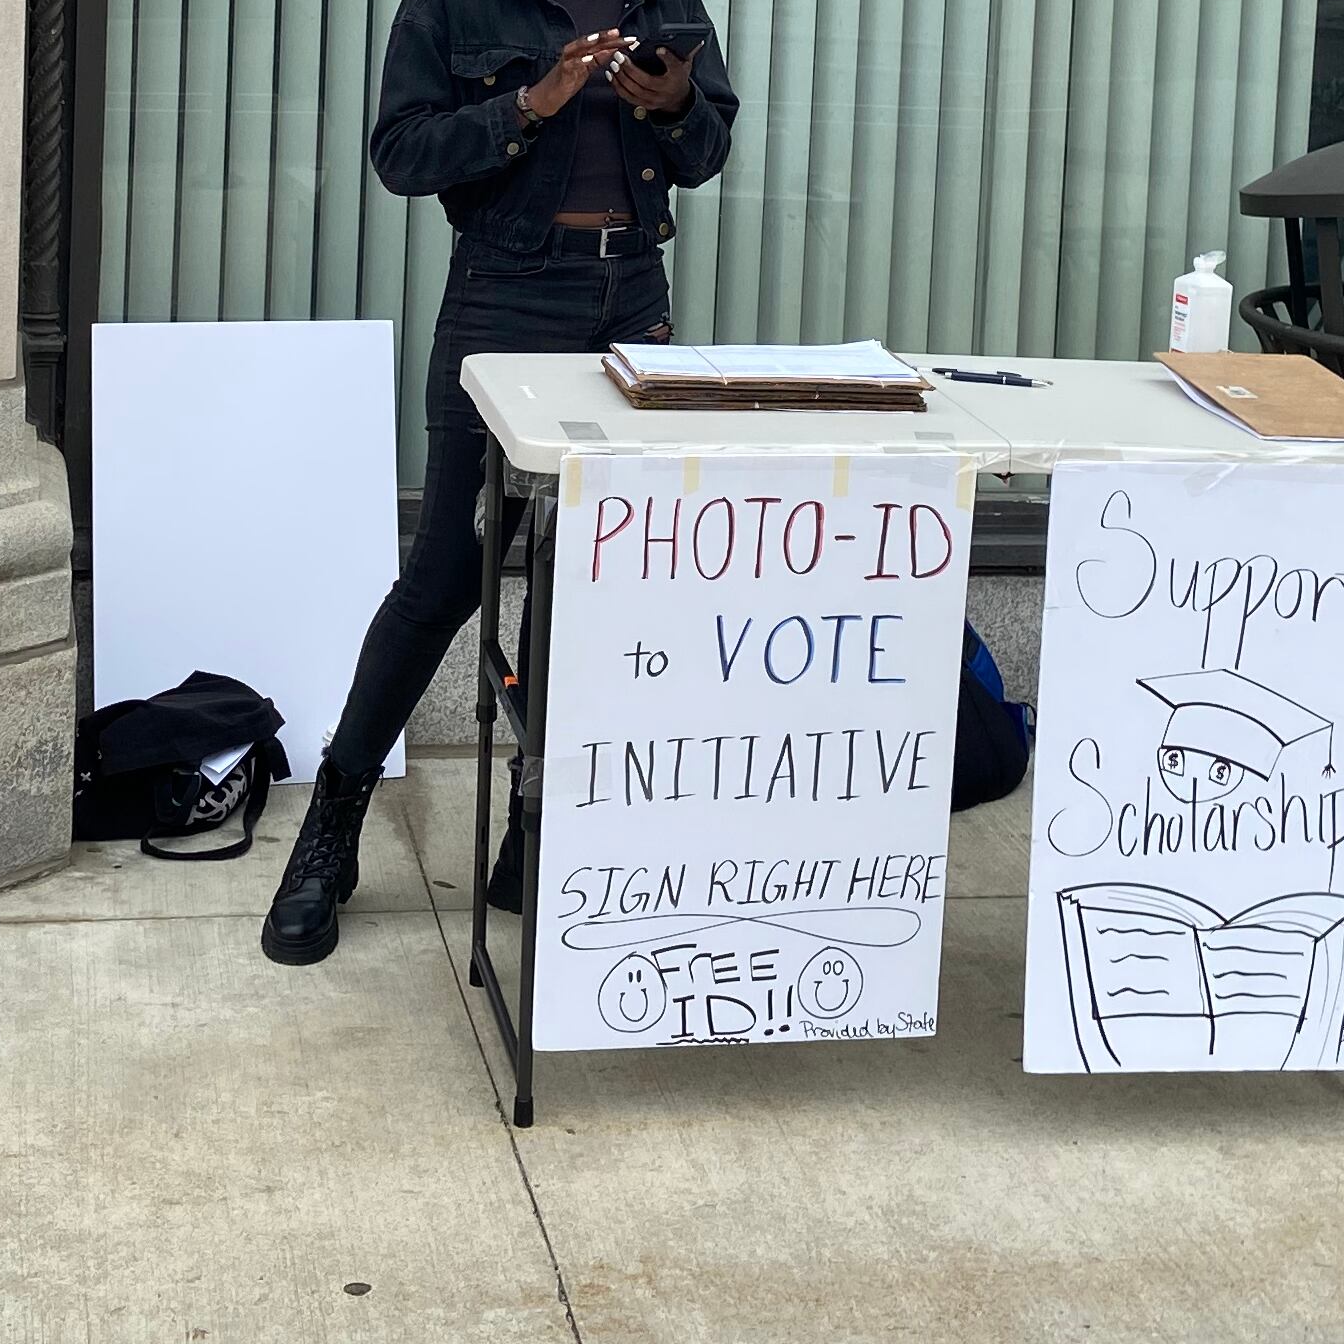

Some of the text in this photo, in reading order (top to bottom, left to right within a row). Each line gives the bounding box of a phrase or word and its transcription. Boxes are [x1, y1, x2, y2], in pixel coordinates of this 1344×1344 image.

[591, 496, 953, 582] PHOTO-ID
[624, 614, 907, 684] to VOTE
[575, 729, 938, 808] INITIATIVE
[557, 854, 947, 919] SIGN RIGHT HERE
[799, 1011, 937, 1040] Provided by State
